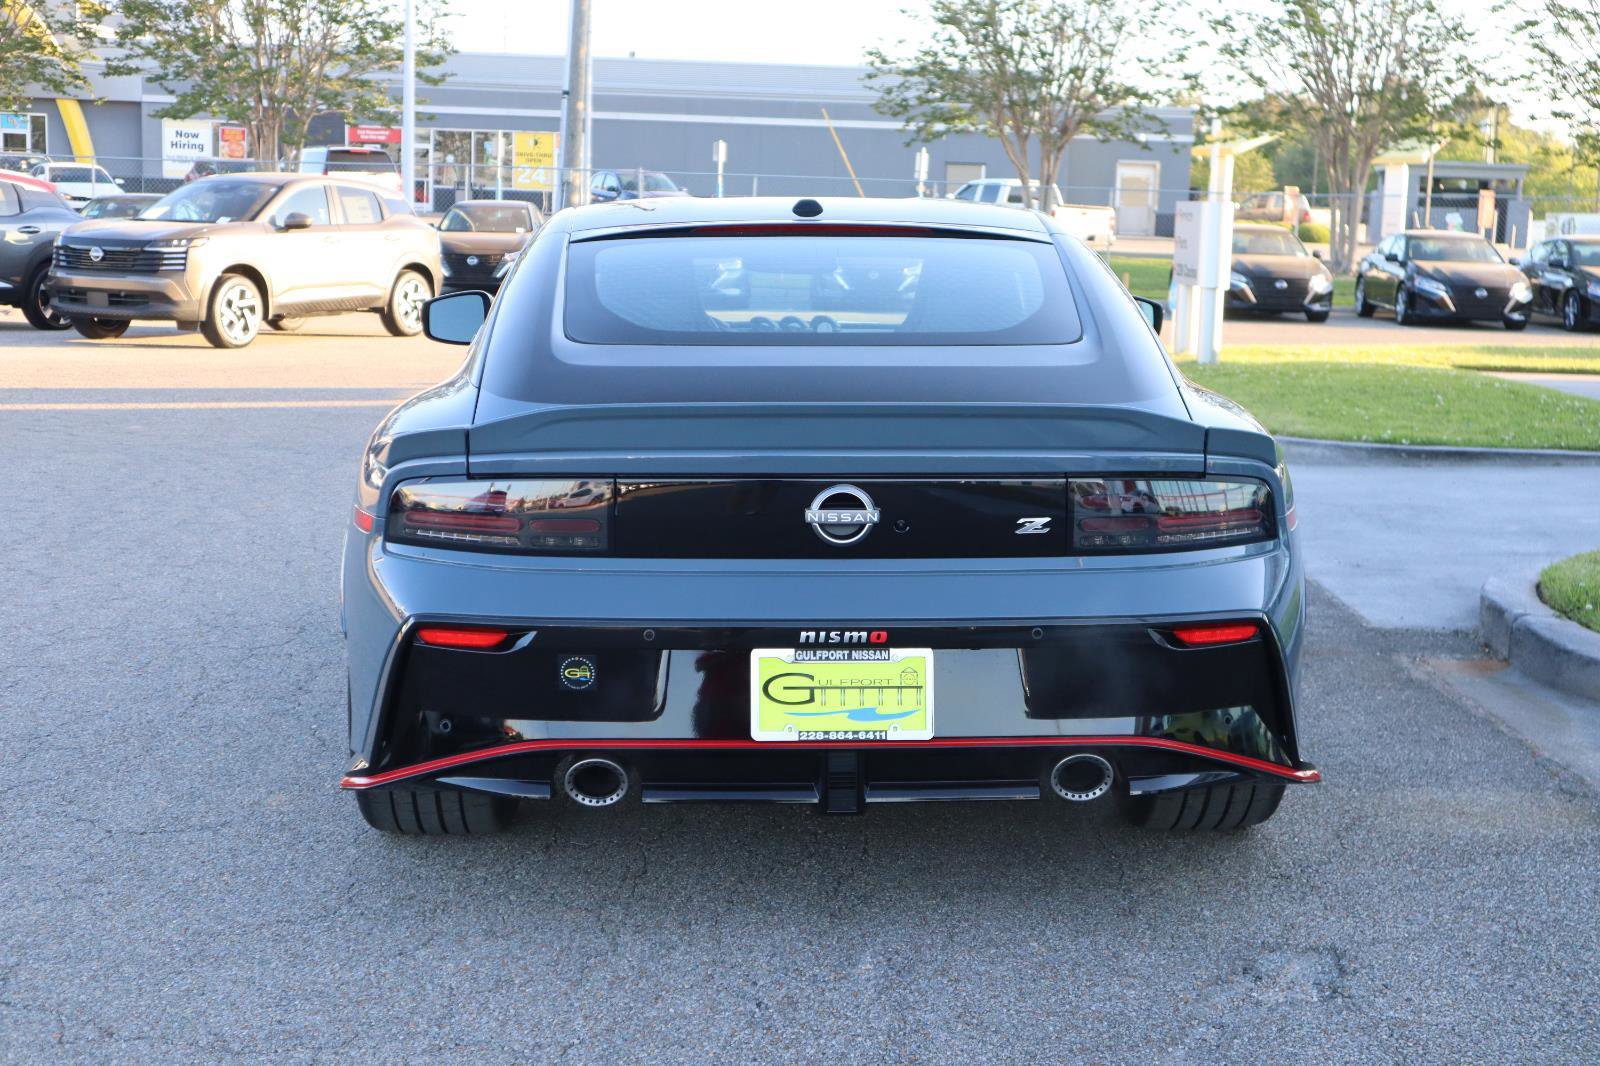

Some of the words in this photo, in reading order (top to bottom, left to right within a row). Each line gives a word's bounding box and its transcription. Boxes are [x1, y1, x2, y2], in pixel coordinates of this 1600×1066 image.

[175, 130, 200, 139] Now
[170, 140, 204, 152] Hiring
[518, 165, 545, 183] 24
[807, 512, 878, 522] NISSAN
[1015, 517, 1052, 534] Z
[799, 630, 888, 643] nismo
[795, 650, 849, 661] GULFPORT
[851, 650, 890, 661] NISSAN
[799, 731, 887, 740] 228-864-6411
